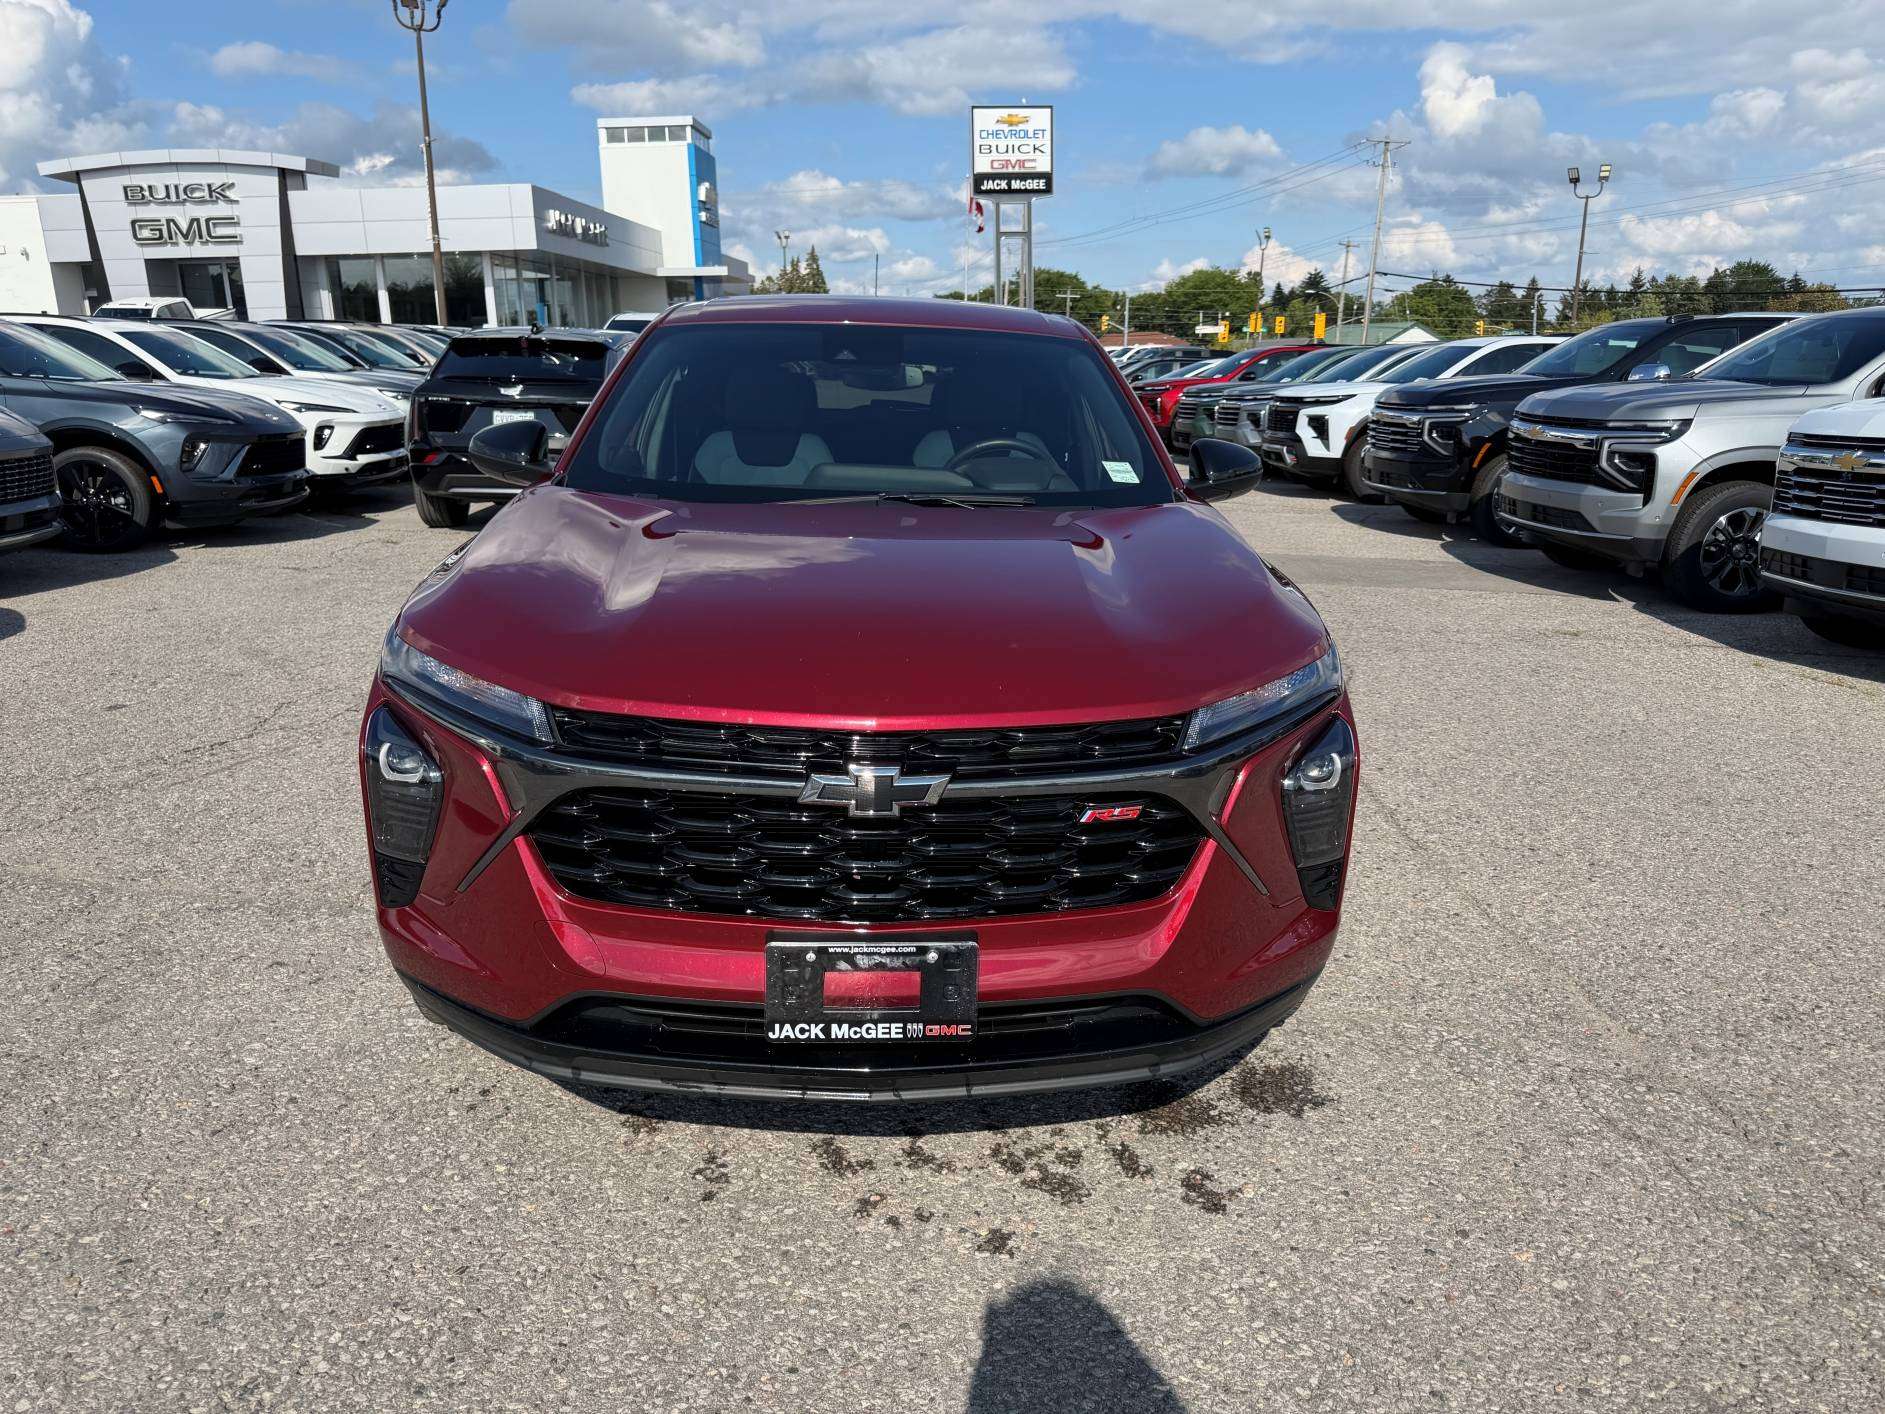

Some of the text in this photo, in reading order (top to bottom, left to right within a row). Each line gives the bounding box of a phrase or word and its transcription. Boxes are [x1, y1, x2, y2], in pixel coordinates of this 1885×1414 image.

[979, 129, 1047, 140] CHEVROLET
[979, 143, 1046, 155] BUICK
[990, 159, 1037, 170] GMC
[980, 179, 1046, 190] JACK McGEE
[122, 182, 239, 204] BUICK
[130, 216, 242, 245] GMC
[1080, 806, 1143, 823] RS
[827, 945, 917, 955] www.jackmcgee.com
[768, 1023, 974, 1039] JACK McGEE GMC
